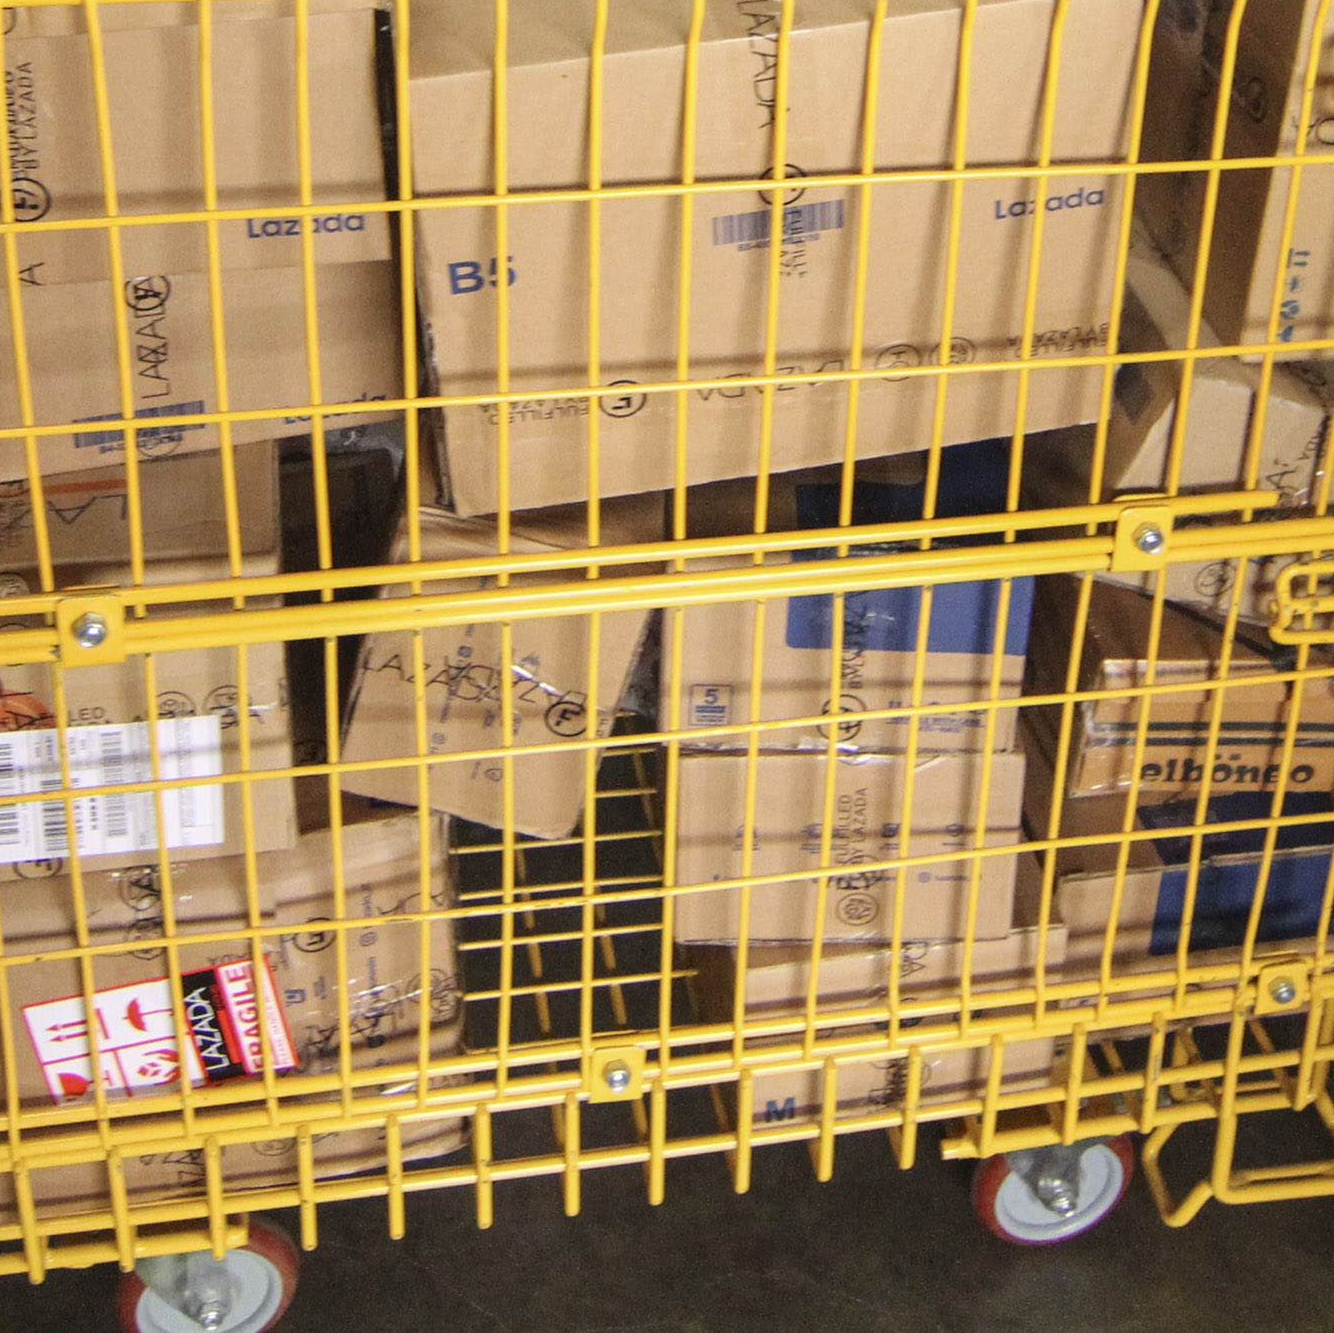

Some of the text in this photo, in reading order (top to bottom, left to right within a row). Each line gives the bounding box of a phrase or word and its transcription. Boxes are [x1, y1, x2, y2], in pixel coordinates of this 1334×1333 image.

[448, 256, 516, 295] B5
[182, 985, 231, 1072] LAZADA
[765, 1096, 796, 1123] M
